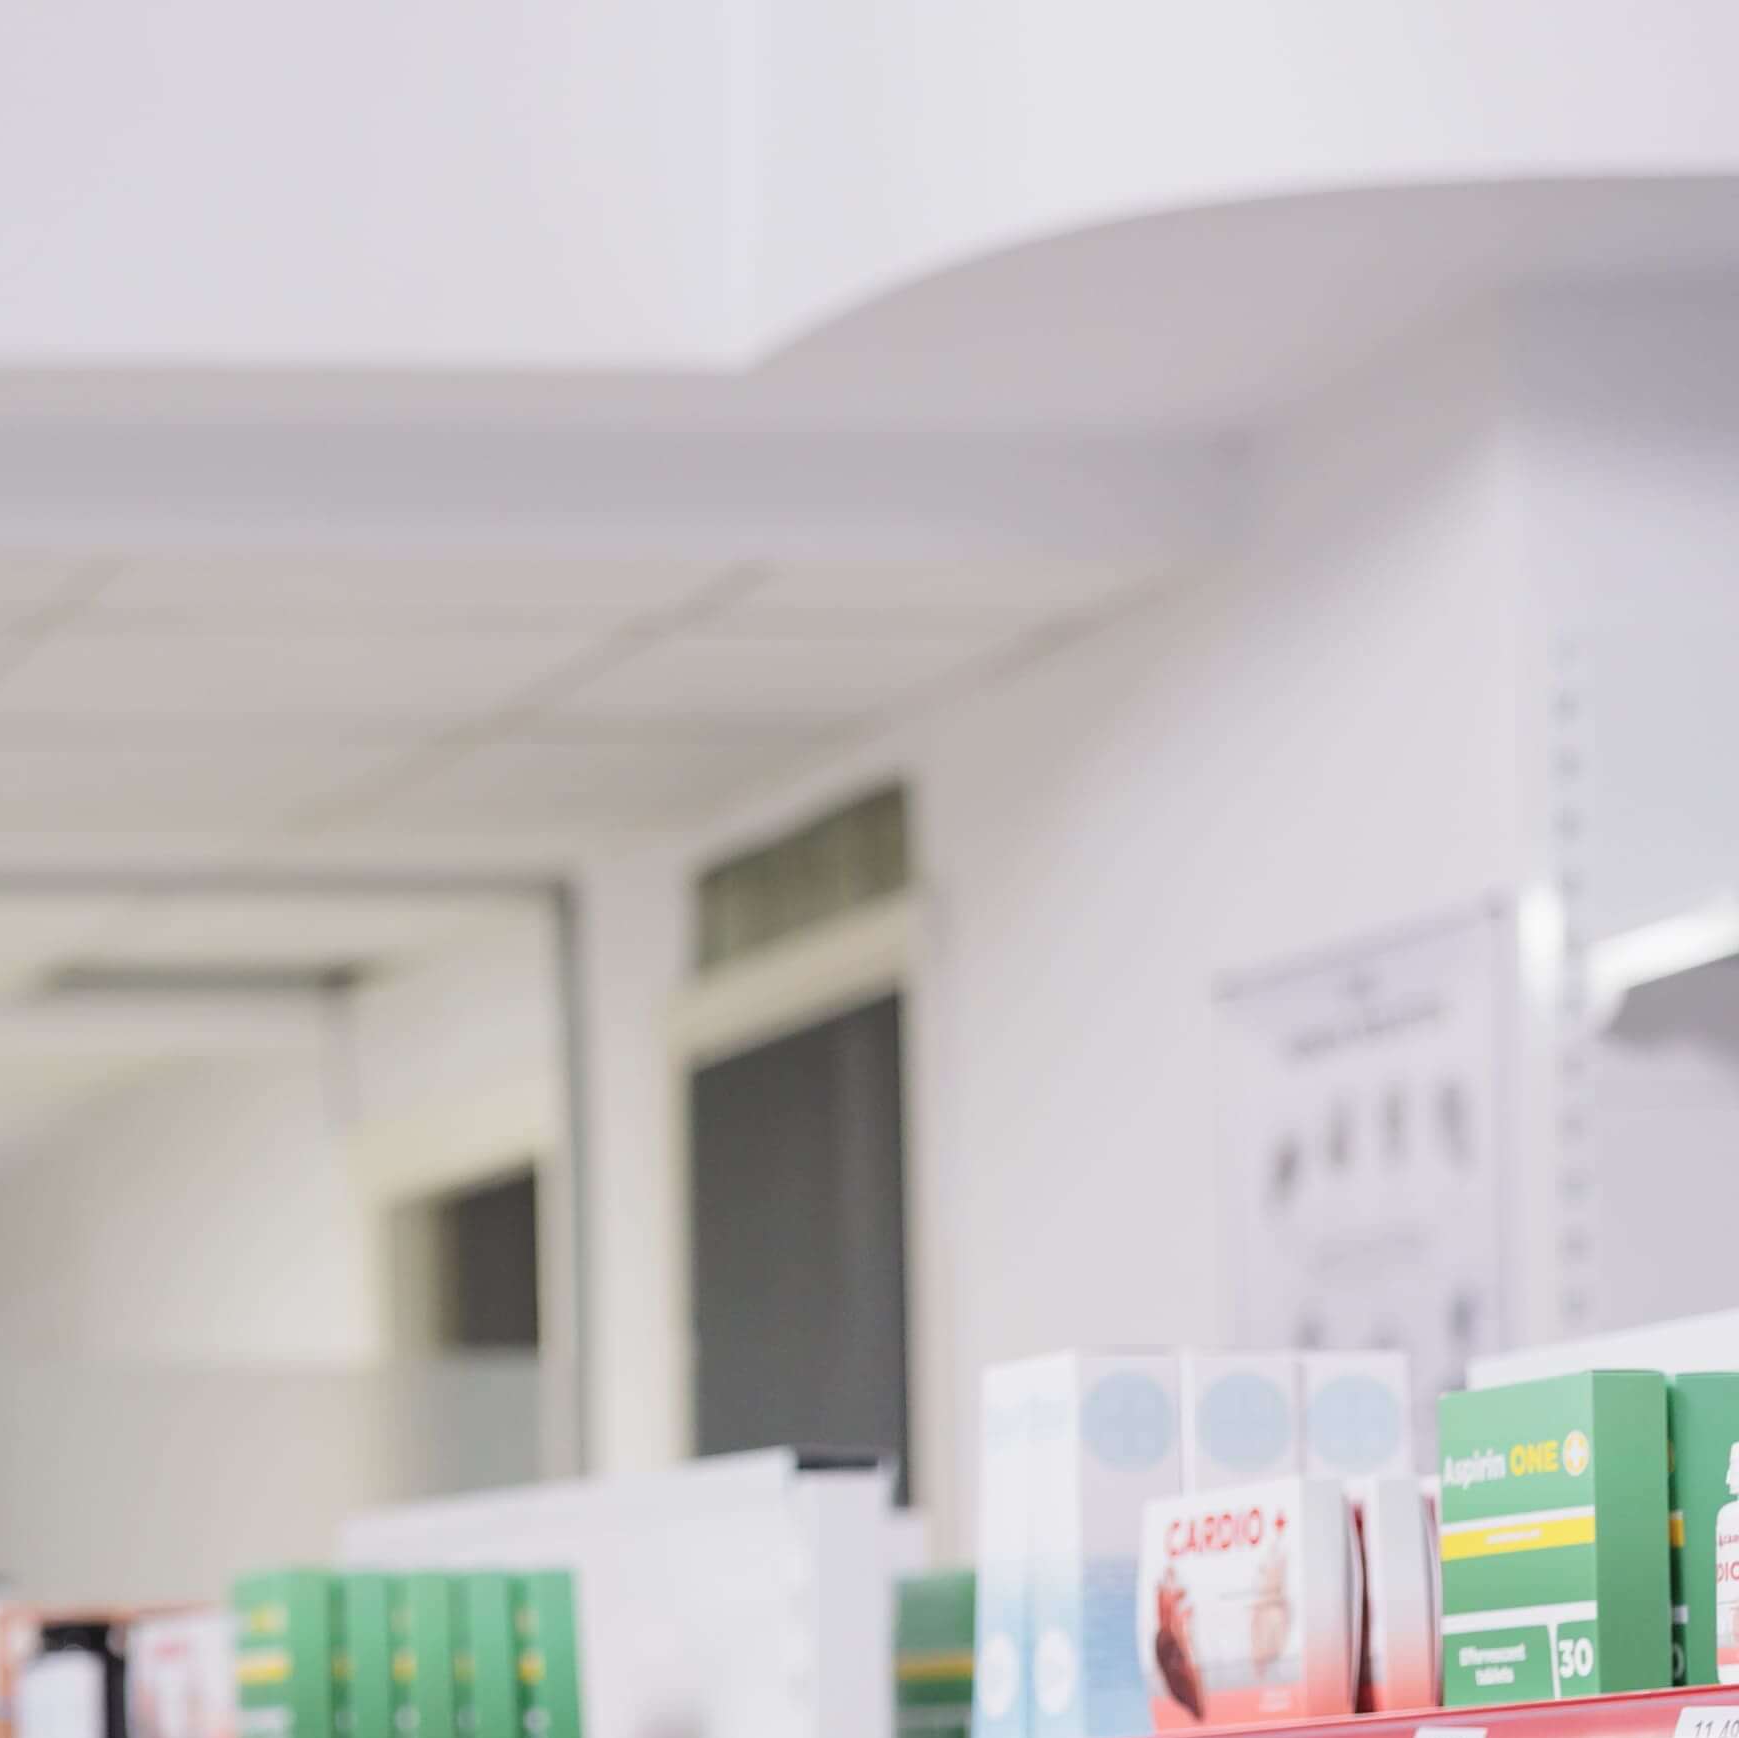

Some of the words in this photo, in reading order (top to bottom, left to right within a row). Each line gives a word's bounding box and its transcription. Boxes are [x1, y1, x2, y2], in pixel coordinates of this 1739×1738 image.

[1443, 1447, 1506, 1490] Aspirin
[1510, 1439, 1559, 1475] ONE
[1163, 1506, 1264, 1559] CARDIO
[1558, 1637, 1594, 1678] 30
